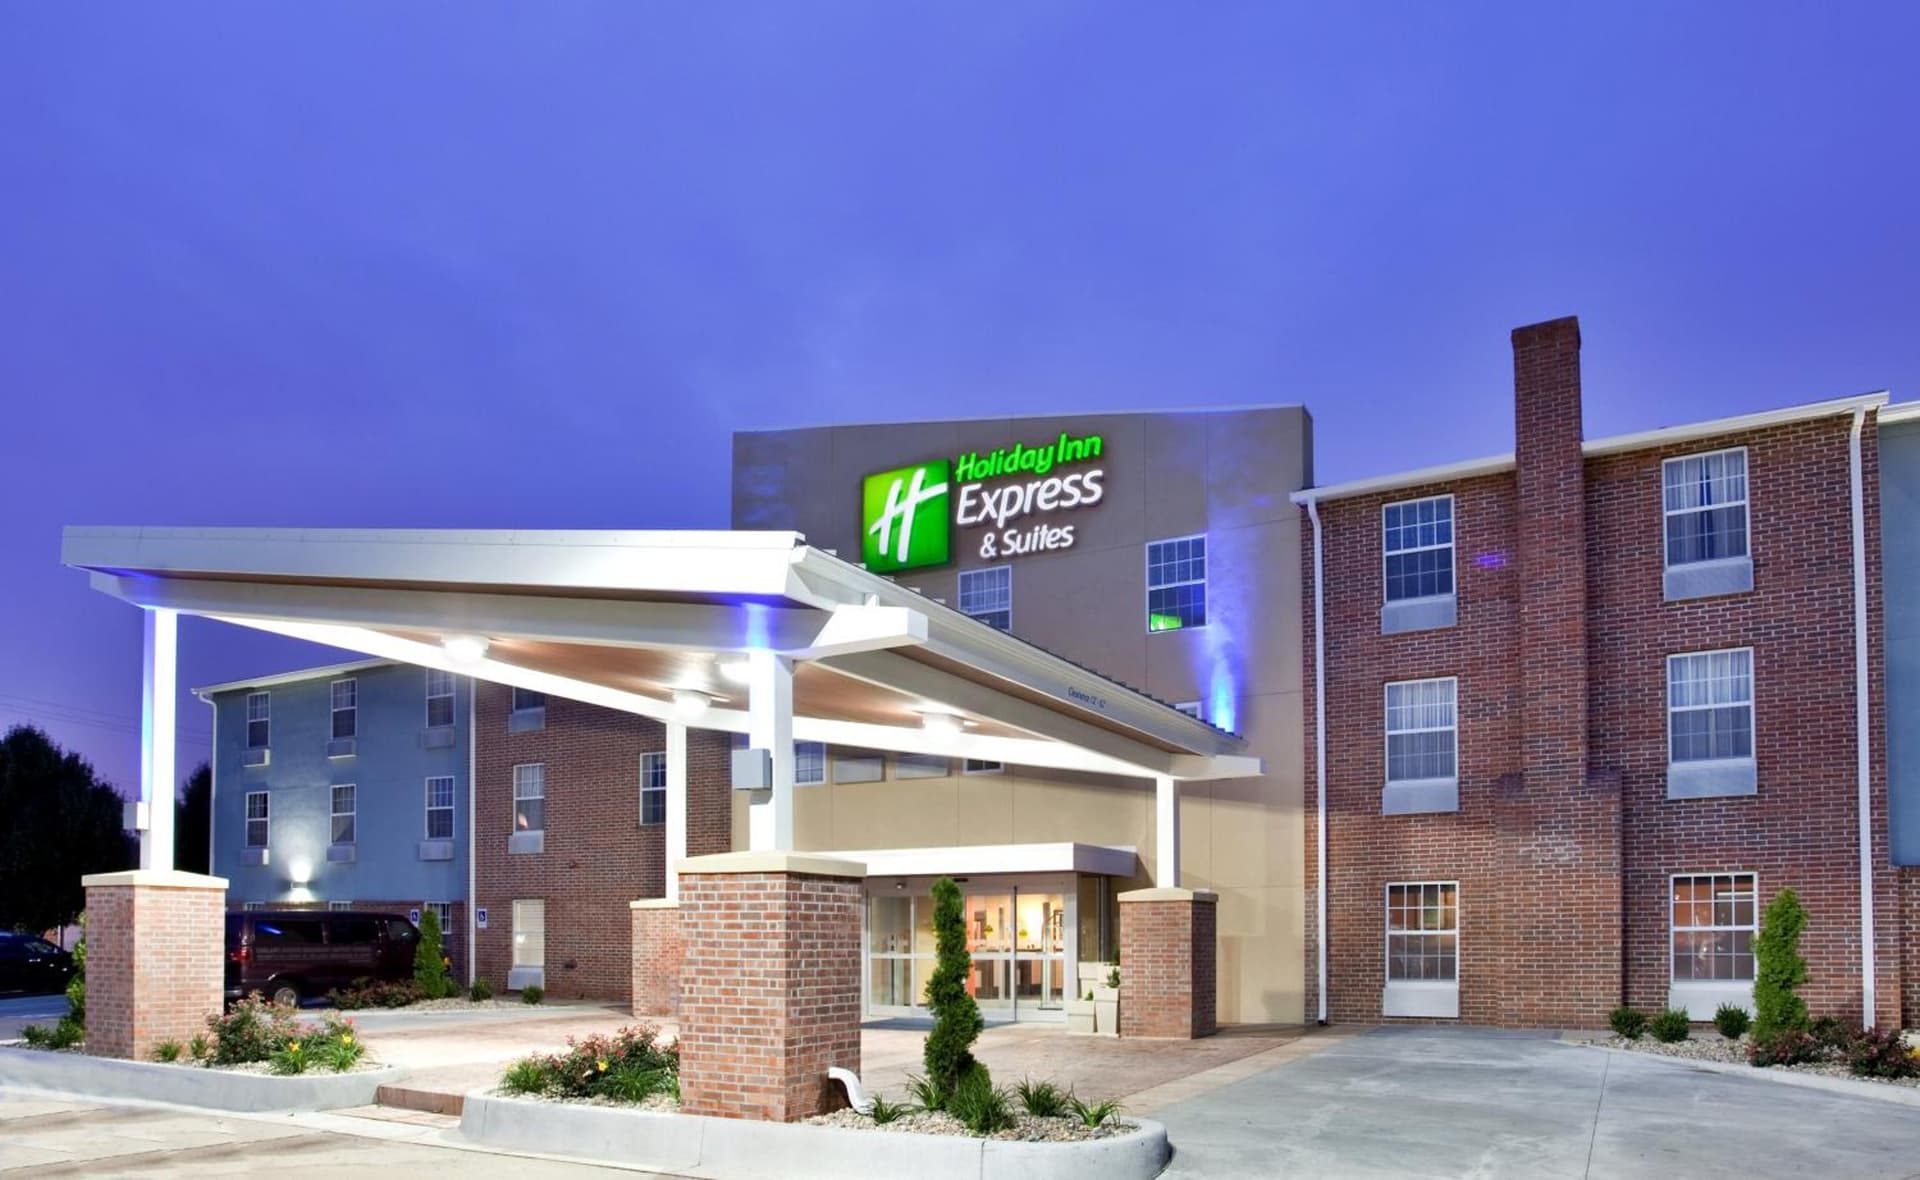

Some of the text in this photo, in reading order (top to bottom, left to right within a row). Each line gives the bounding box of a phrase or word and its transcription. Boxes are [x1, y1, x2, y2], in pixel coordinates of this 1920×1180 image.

[955, 433, 1101, 482] Holiday Inn
[956, 469, 1104, 529] Express
[979, 524, 1074, 558] & Suites
